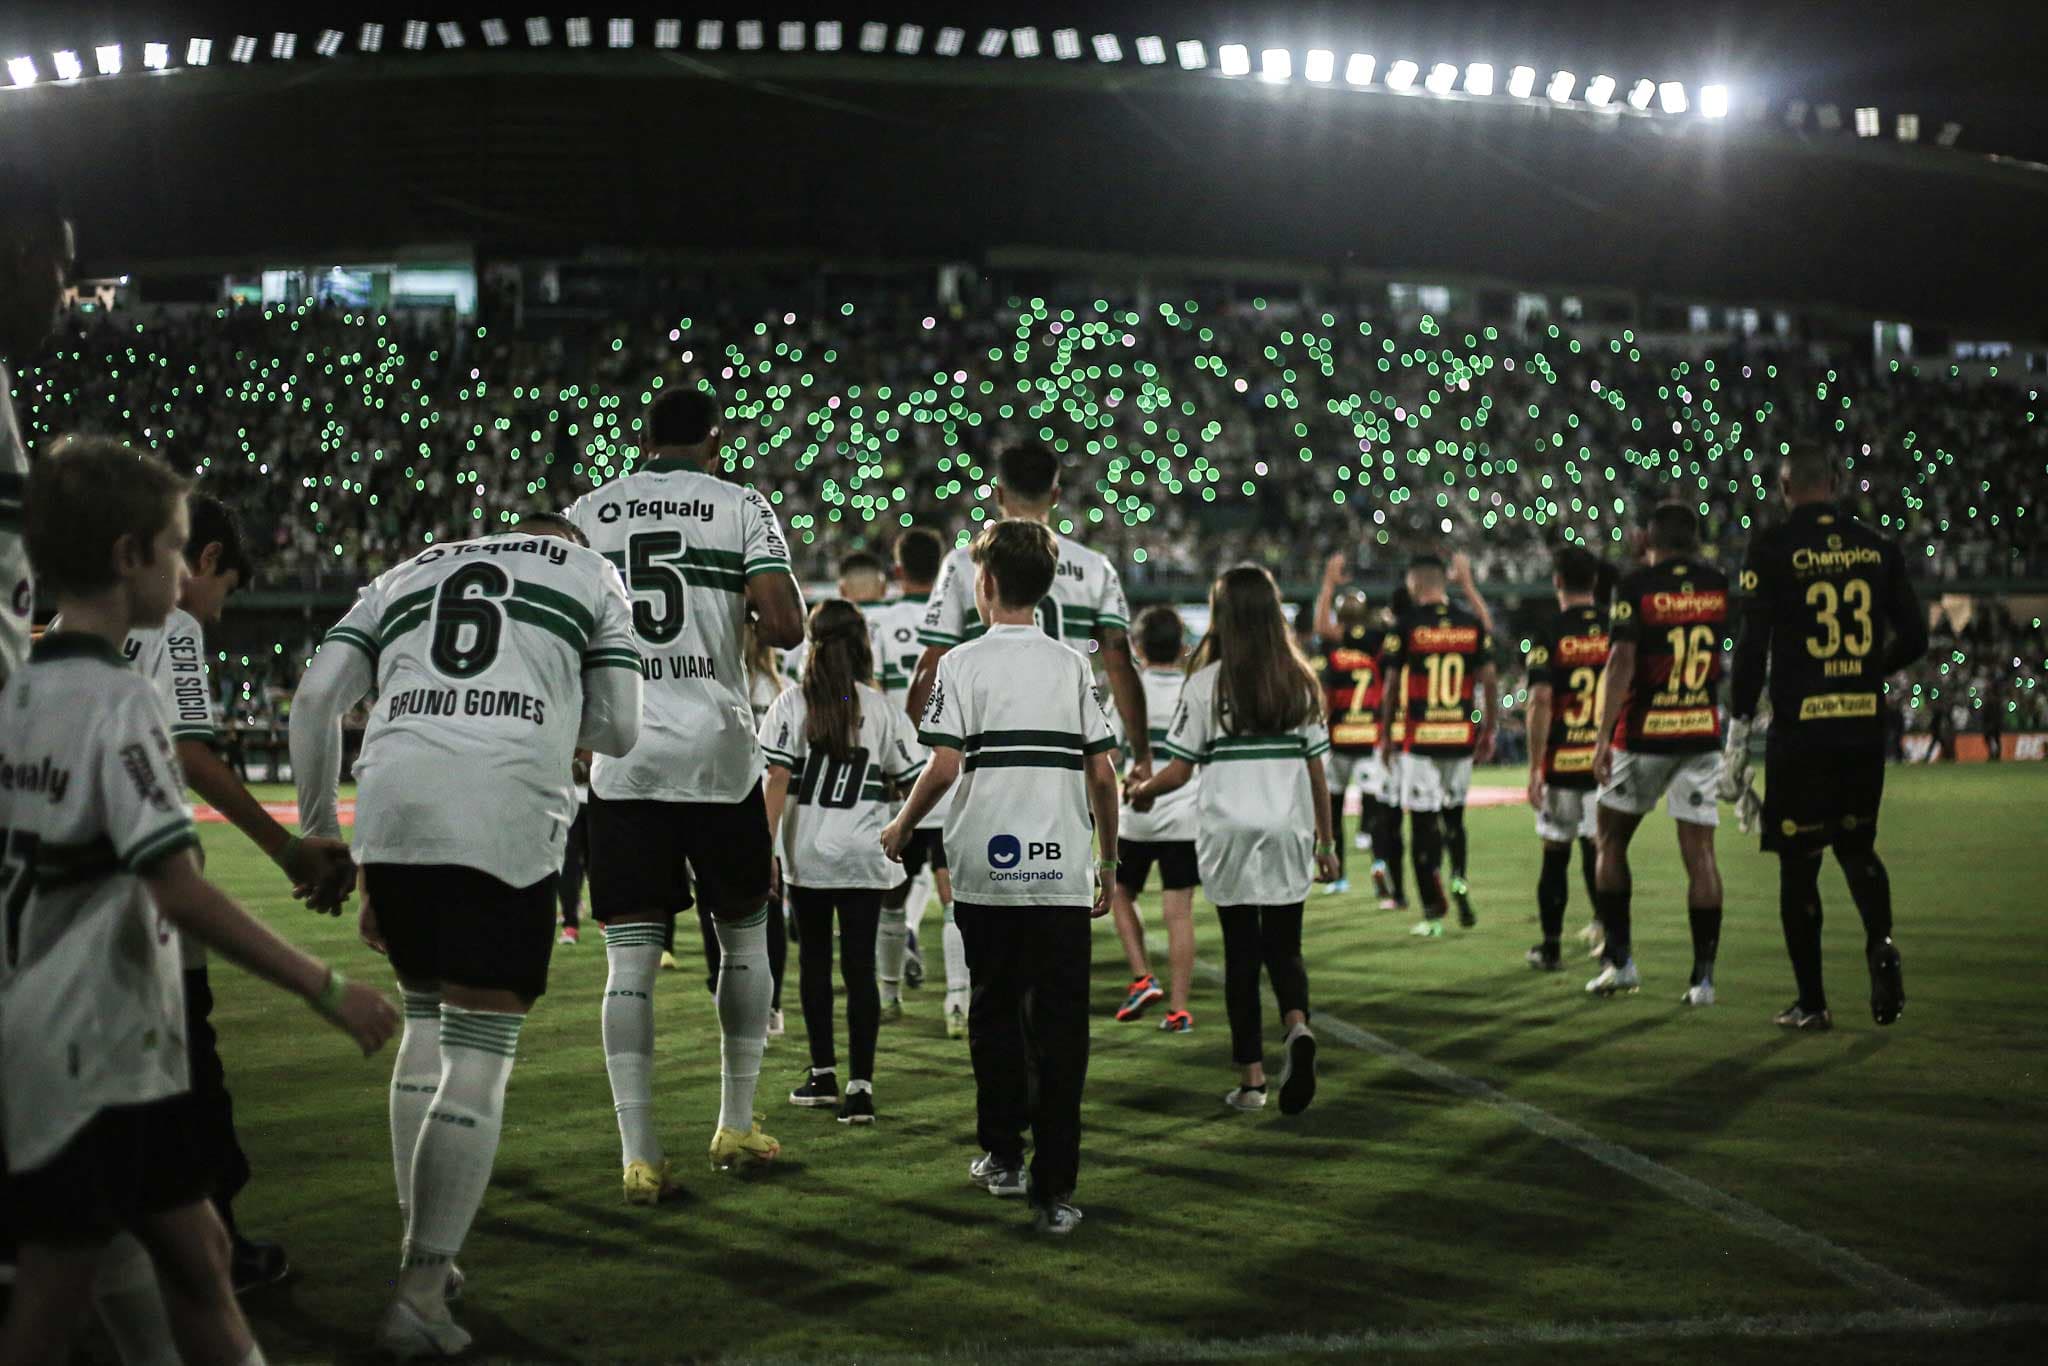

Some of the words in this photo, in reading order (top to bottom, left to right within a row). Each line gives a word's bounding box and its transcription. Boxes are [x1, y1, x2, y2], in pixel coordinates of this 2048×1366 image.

[626, 499, 714, 522] Tequaly
[452, 540, 569, 566] Tequaly
[1792, 547, 1882, 571] Champion
[629, 530, 686, 645] 5
[430, 560, 510, 680] 6
[1805, 578, 1874, 659] 33
[167, 636, 199, 672] SEJA
[670, 656, 716, 680] VIANA
[1667, 624, 1715, 694] 16
[174, 677, 209, 720] SÓCIO
[1351, 667, 1373, 716] 7
[1424, 653, 1466, 708] 10
[388, 688, 457, 722] BRUNO
[464, 689, 545, 726] GOMES
[1028, 842, 1062, 860] PB
[989, 869, 1064, 882] Consignado
